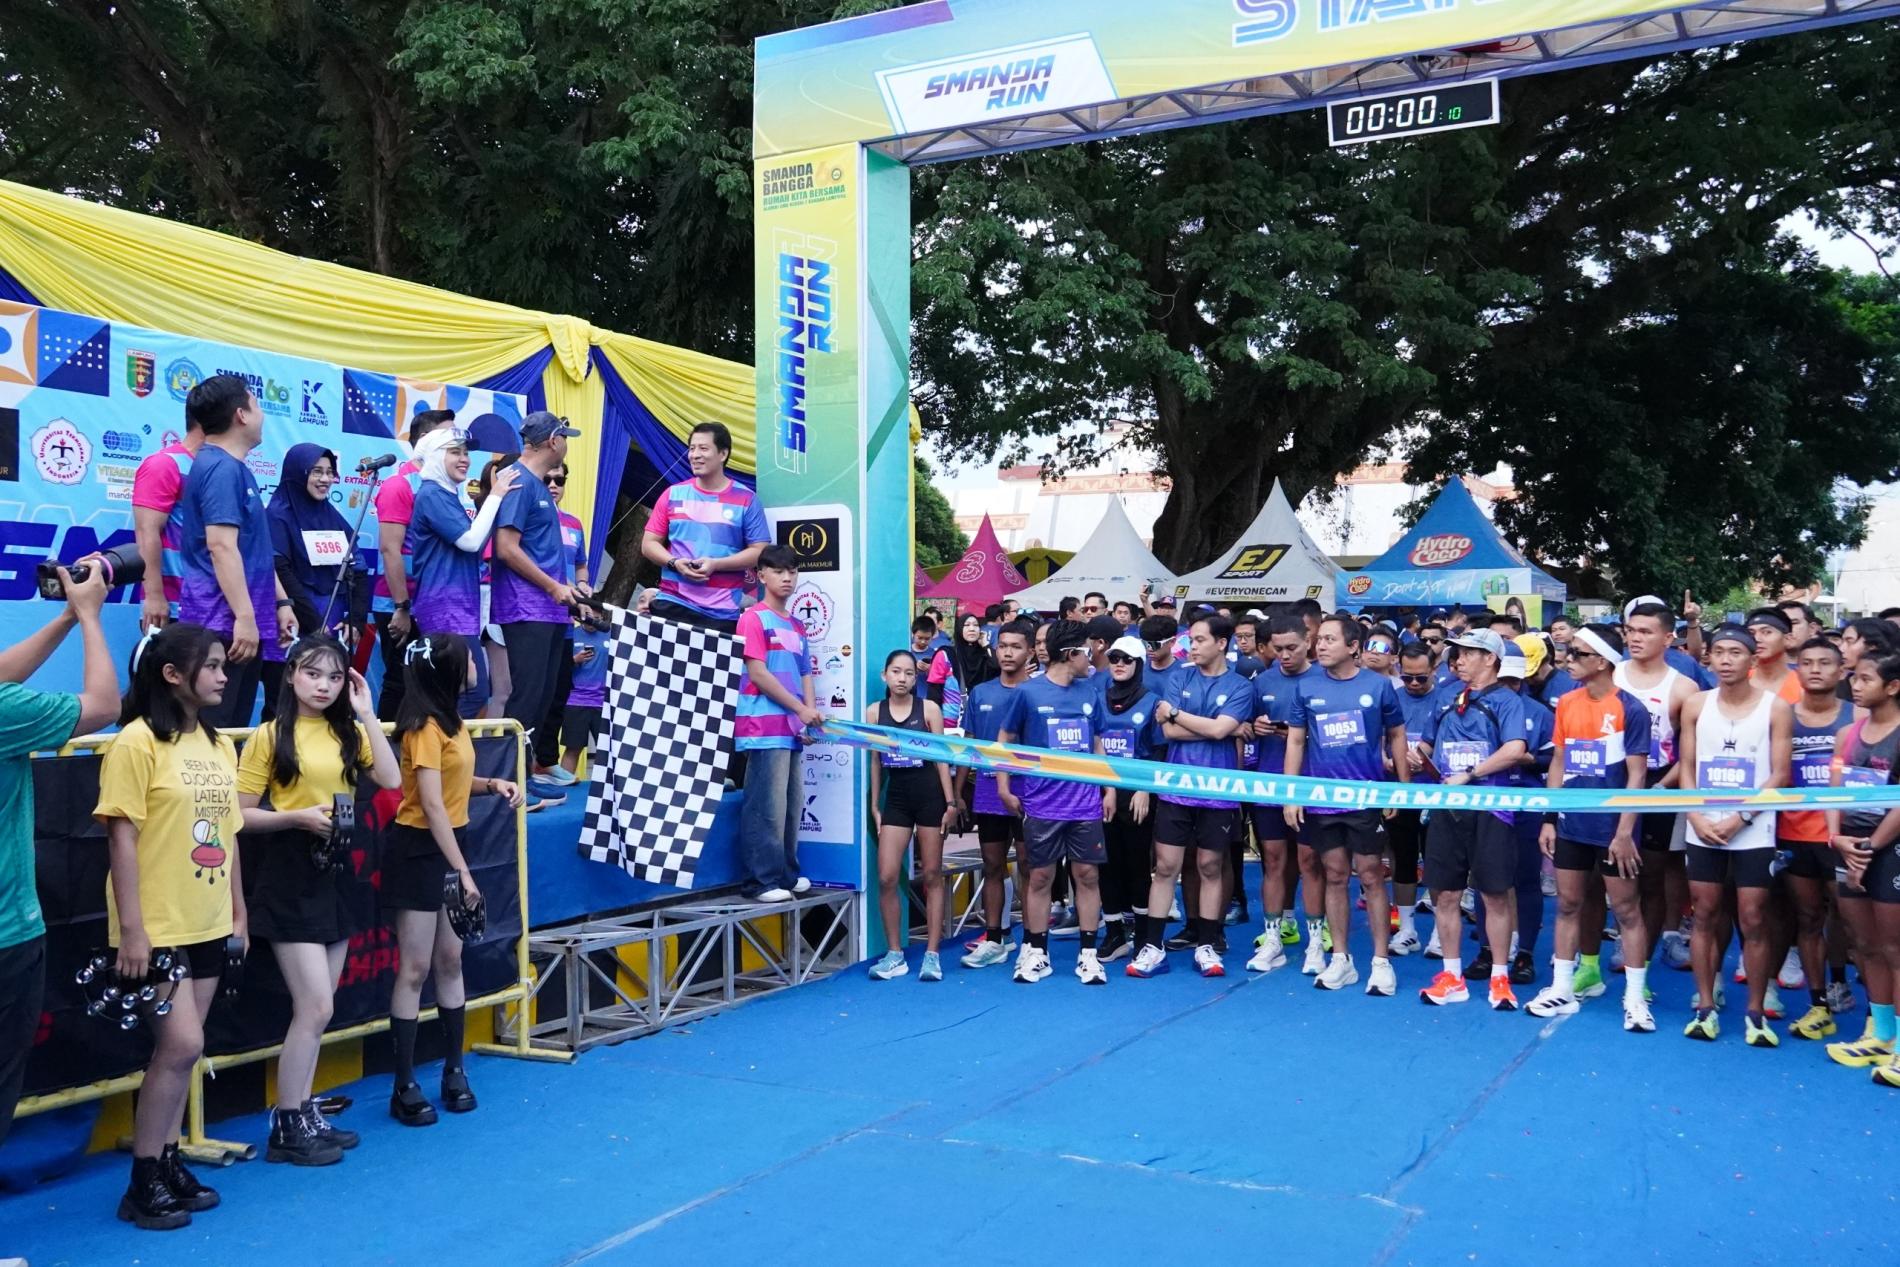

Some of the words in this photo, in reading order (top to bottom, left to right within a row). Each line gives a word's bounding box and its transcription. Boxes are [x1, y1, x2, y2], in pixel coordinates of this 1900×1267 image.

[924, 55, 1057, 100] SMANDA
[985, 81, 1049, 112] RUN
[763, 162, 814, 183] SMANDA
[763, 176, 814, 196] BANGGA
[763, 195, 789, 206] RUMAH
[791, 191, 808, 200] KITA
[809, 184, 846, 198] BERSAMA
[807, 258, 832, 354] RUN
[779, 252, 807, 454] SMANDA
[299, 416, 329, 427] LAMPUNG
[40, 430, 63, 458] UNIVERSITAS
[109, 491, 132, 500] mand
[315, 541, 342, 553] 5396
[1415, 535, 1473, 553] Hydro
[956, 550, 986, 583] 3
[1231, 549, 1284, 570] EJ
[1222, 570, 1266, 578] SPORT
[1349, 576, 1372, 586] Hydro
[1205, 586, 1288, 596] #EVERYONECAN
[1056, 728, 1082, 741] 10011
[1323, 720, 1358, 737] 10053
[1101, 737, 1128, 750] 10012
[1570, 749, 1599, 765] 10130
[183, 759, 209, 772] BEEN
[210, 760, 222, 771] IN
[1800, 764, 1831, 780] 1016
[1706, 767, 1746, 783] 10160
[194, 789, 231, 804] LATELY,
[194, 806, 231, 818] MISTER?
